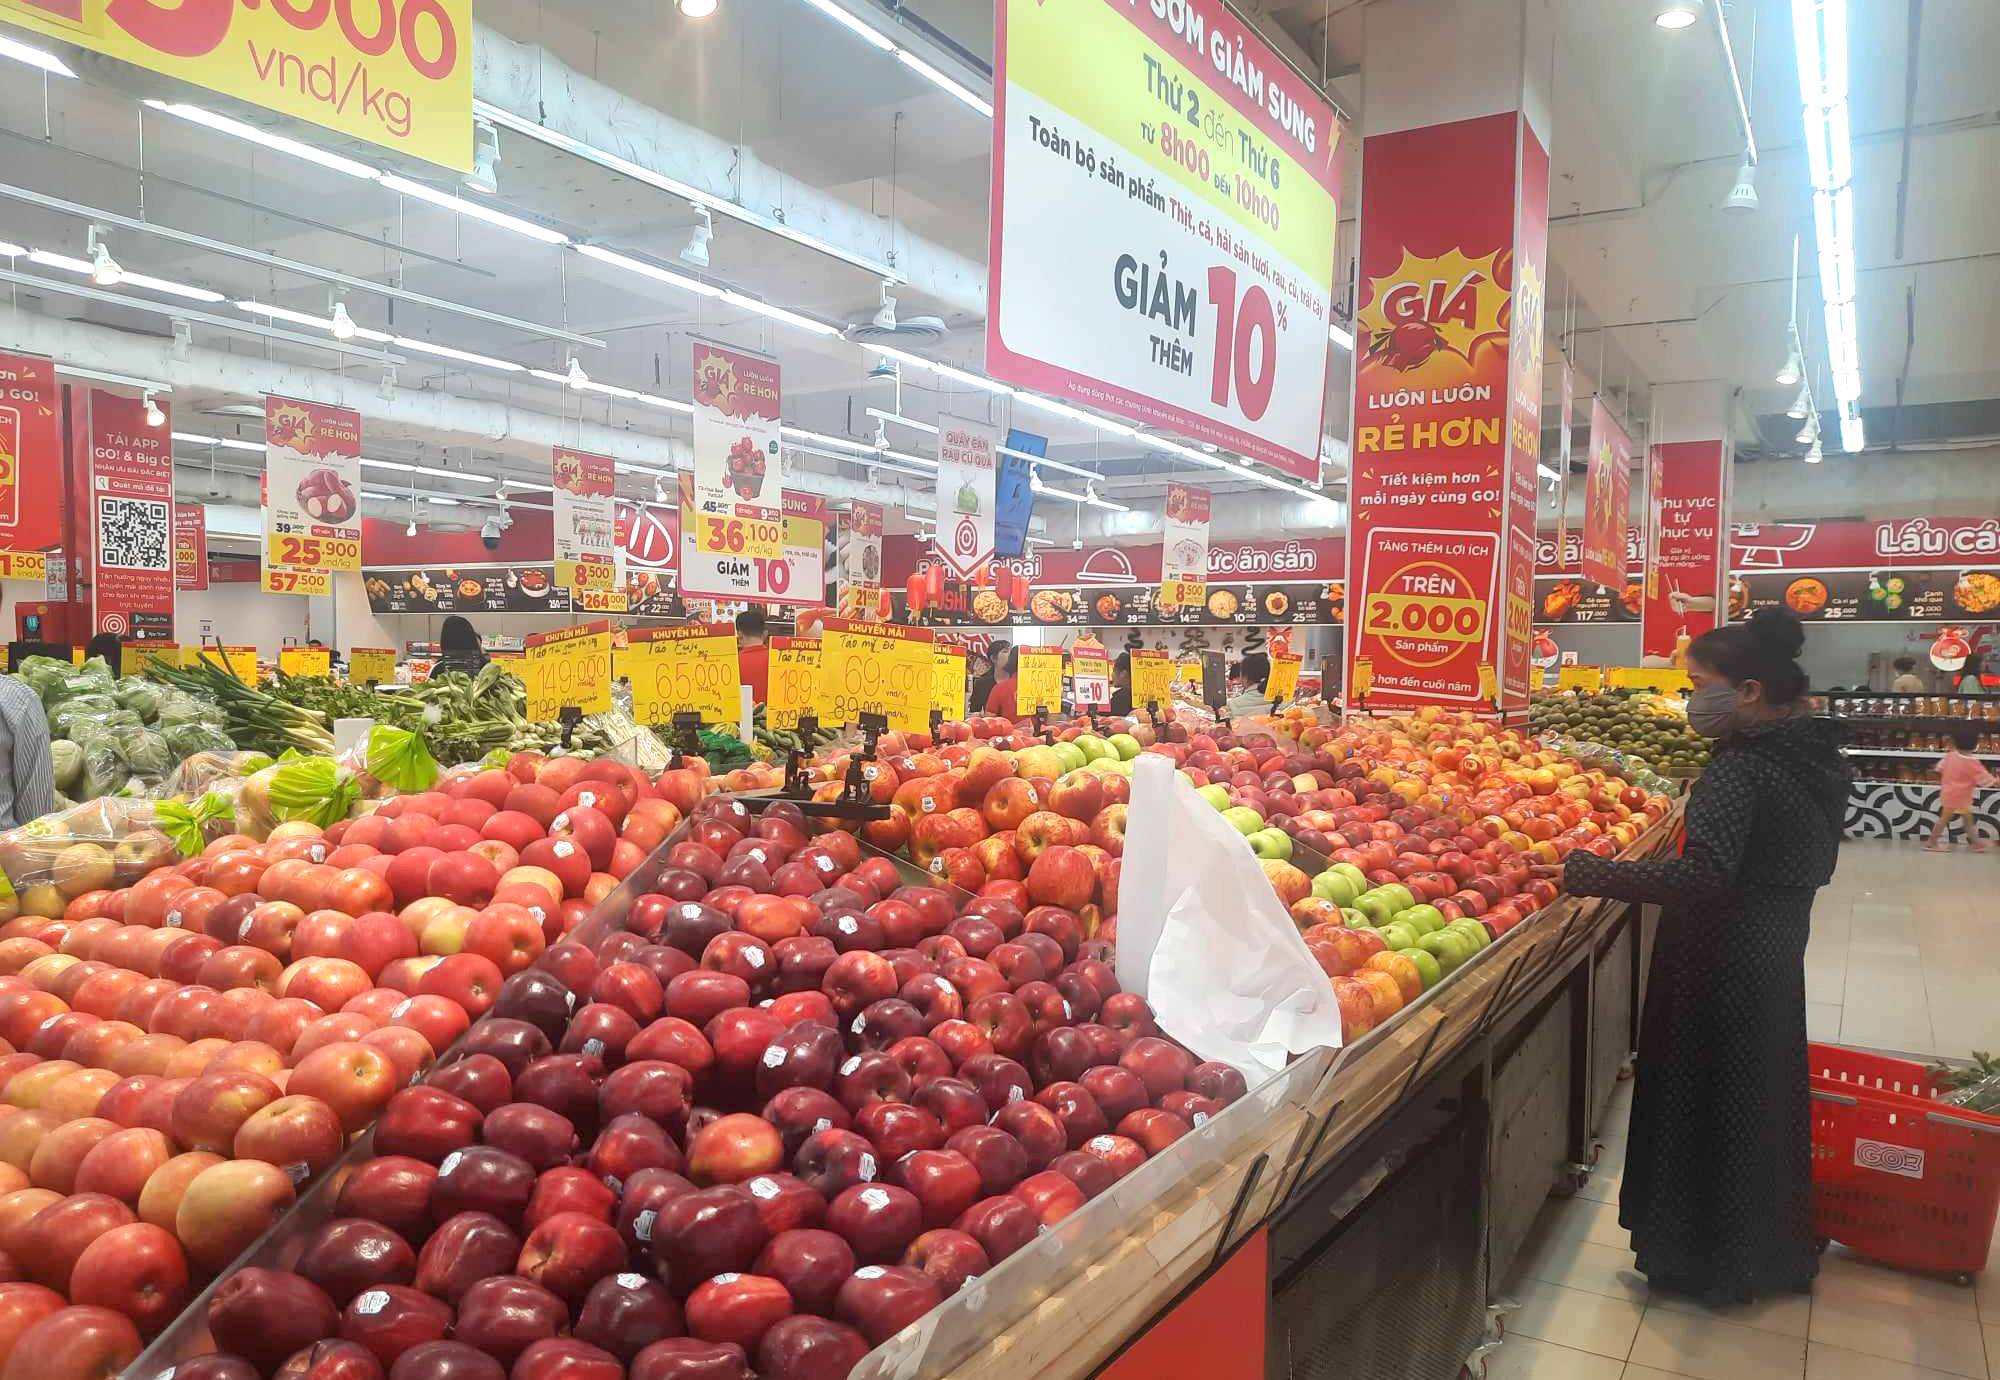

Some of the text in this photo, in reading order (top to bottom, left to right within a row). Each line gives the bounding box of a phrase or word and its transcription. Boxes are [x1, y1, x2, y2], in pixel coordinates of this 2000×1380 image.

[248, 40, 412, 137] vnd/kg
[1210, 30, 1265, 107] GIẢM
[1268, 82, 1316, 153] SUNG
[1143, 52, 1280, 190] Thứ 2 đến Thứ 6
[1160, 122, 1210, 181] 8h00
[1234, 174, 1280, 232] 10h00
[1029, 115, 1070, 159] Toàn
[1076, 141, 1096, 178] bộ
[1100, 157, 1125, 190] sản
[1129, 179, 1165, 213] phẩm
[1170, 197, 1196, 235] Thịt,
[1199, 220, 1214, 246] cá,
[1216, 227, 1232, 254] hải
[1234, 240, 1250, 266] sản
[1114, 249, 1197, 337] GIẢM
[1381, 271, 1487, 331] GIÁ
[1150, 334, 1194, 377] THÊM
[9, 388, 39, 402] GO!
[1369, 387, 1425, 409] LUÔN
[1431, 382, 1492, 405] LUÔN
[106, 432, 159, 450] TẢI APP
[1358, 413, 1501, 453] RẺ HƠN
[95, 447, 171, 467] GO! & Big C
[1380, 472, 1481, 487] Tiết kiệm hơn
[1360, 490, 1500, 507] mỗi ngày cùng GO!
[1686, 496, 1717, 511] vực
[1674, 511, 1693, 526] tự
[707, 518, 779, 553] 36.100
[1694, 527, 1713, 540] vụ
[1880, 520, 1944, 552] Lẩu
[281, 537, 358, 566] 25.900
[1240, 549, 1268, 570] ăn
[1273, 541, 1314, 570] sẵn
[1378, 540, 1489, 557] TĂNG THÊM LỢI ÍCH
[575, 564, 610, 585] 8.500
[717, 557, 750, 577] GIẢM
[270, 572, 325, 592] 57.500
[732, 579, 750, 587] THÊM
[1402, 573, 1457, 595] TRÊN
[585, 594, 626, 609] 264.000
[1909, 606, 1942, 617] 12.000
[1369, 601, 1480, 636] 2.000
[1824, 607, 1858, 617] 25.000
[544, 631, 574, 643] KHUYẾN
[653, 628, 689, 640] KHUYẾN
[848, 621, 885, 637] KHUYẾN
[791, 640, 818, 650] KHUYẾN
[1395, 638, 1449, 654] Sản phẩm
[537, 655, 607, 700] 149.000
[655, 663, 732, 700] 65.000
[846, 655, 935, 697] 69.000
[1378, 673, 1472, 692] hơn đến cuối năm
